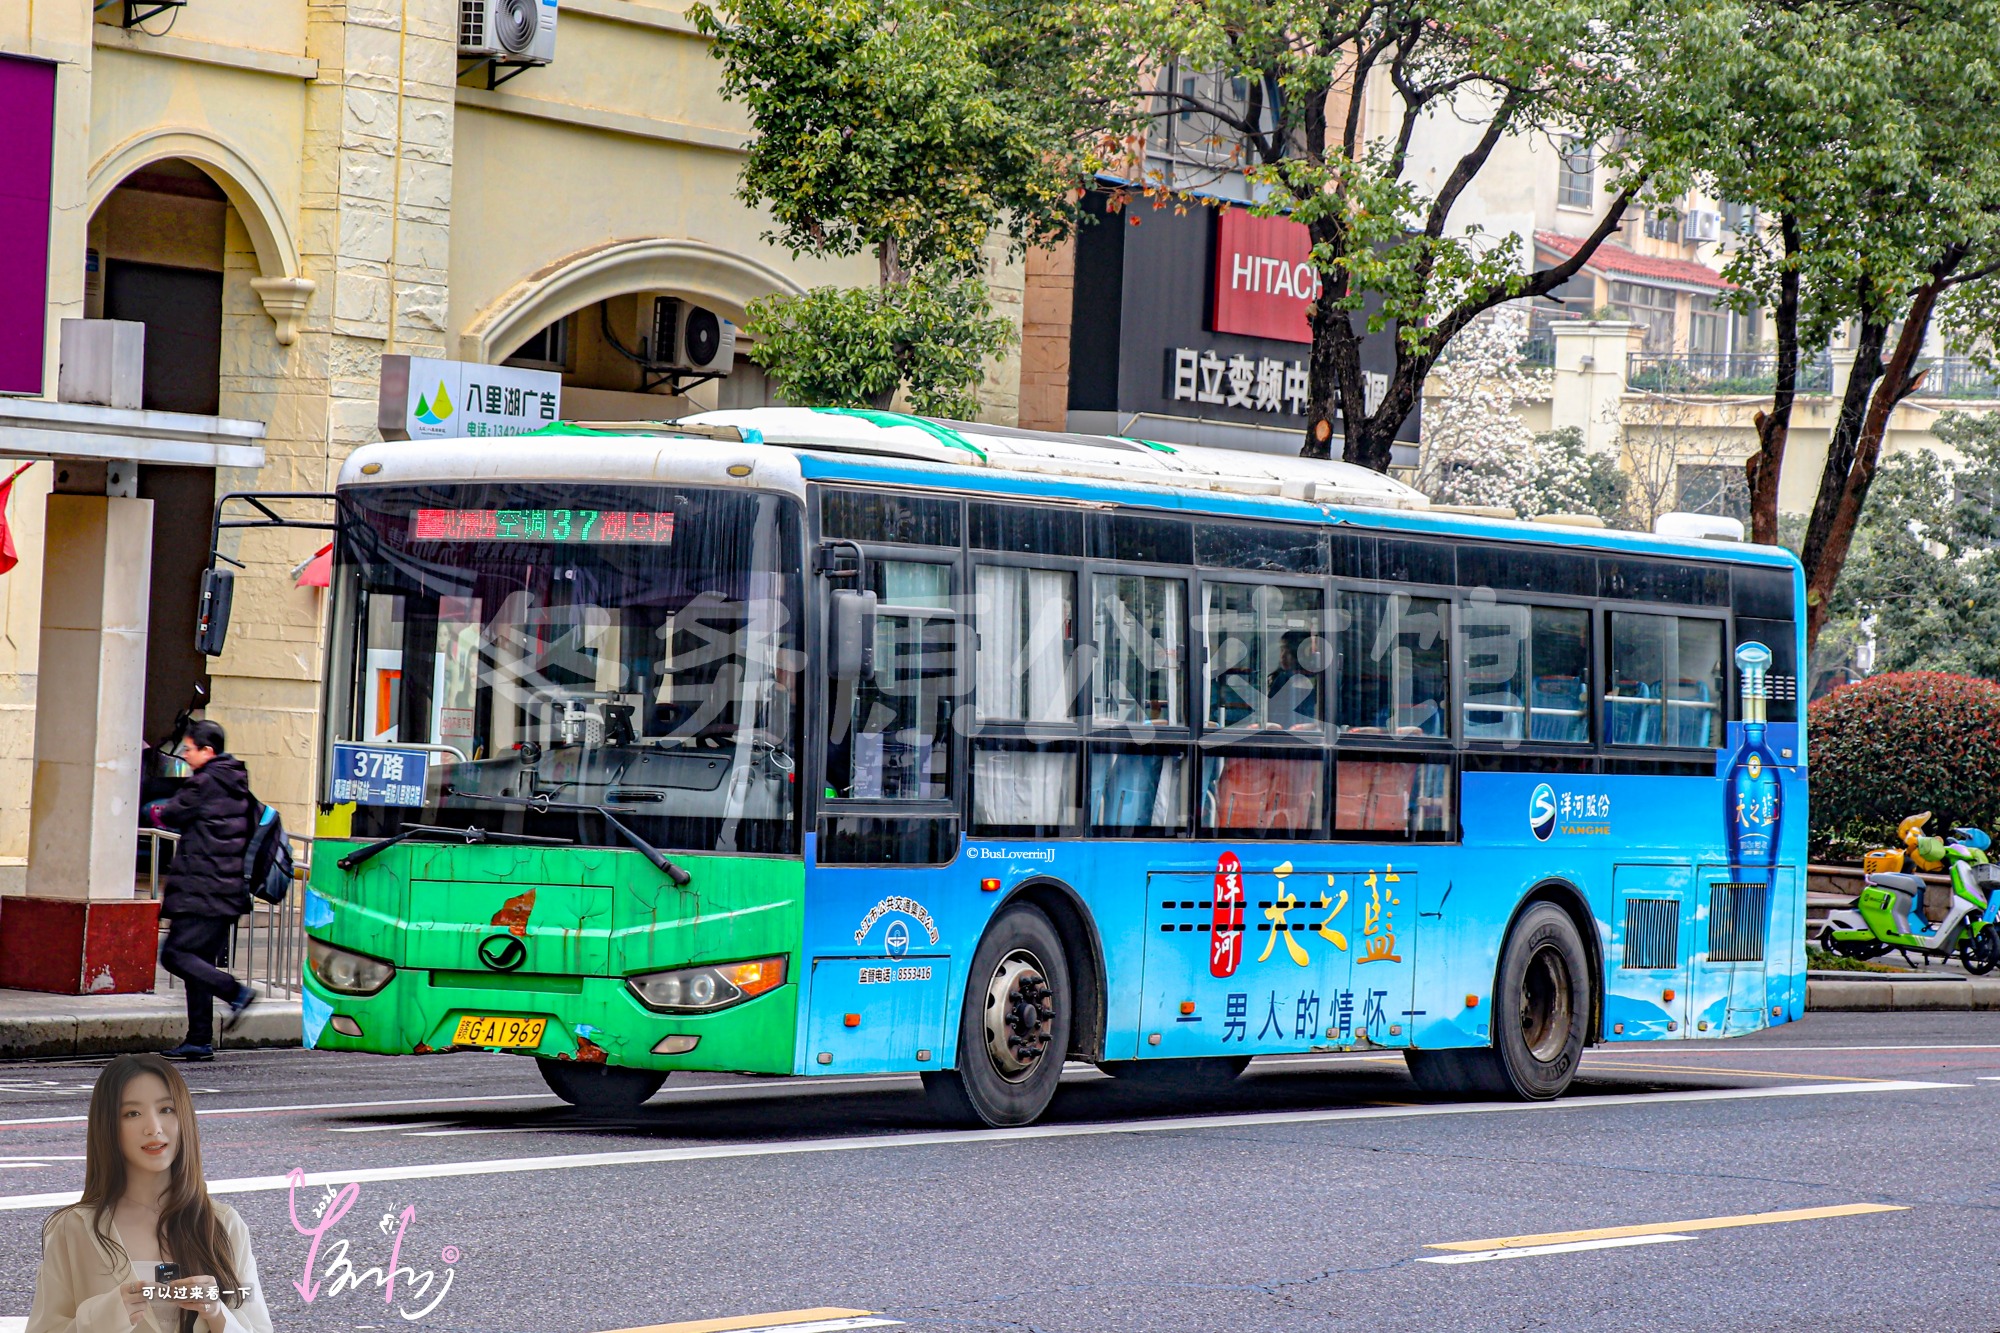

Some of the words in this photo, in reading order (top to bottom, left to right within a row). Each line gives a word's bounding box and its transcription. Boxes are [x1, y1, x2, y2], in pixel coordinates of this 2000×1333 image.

[1232, 253, 1322, 300] HITAC
[1173, 347, 1389, 418] 日立变频中调
[466, 383, 556, 420] 八里湖广告
[353, 752, 404, 781] 37路
[1560, 792, 1610, 821] 洋河股份
[1560, 826, 1611, 835] YANGHE
[854, 895, 939, 946] 九江市公共交通集团公司
